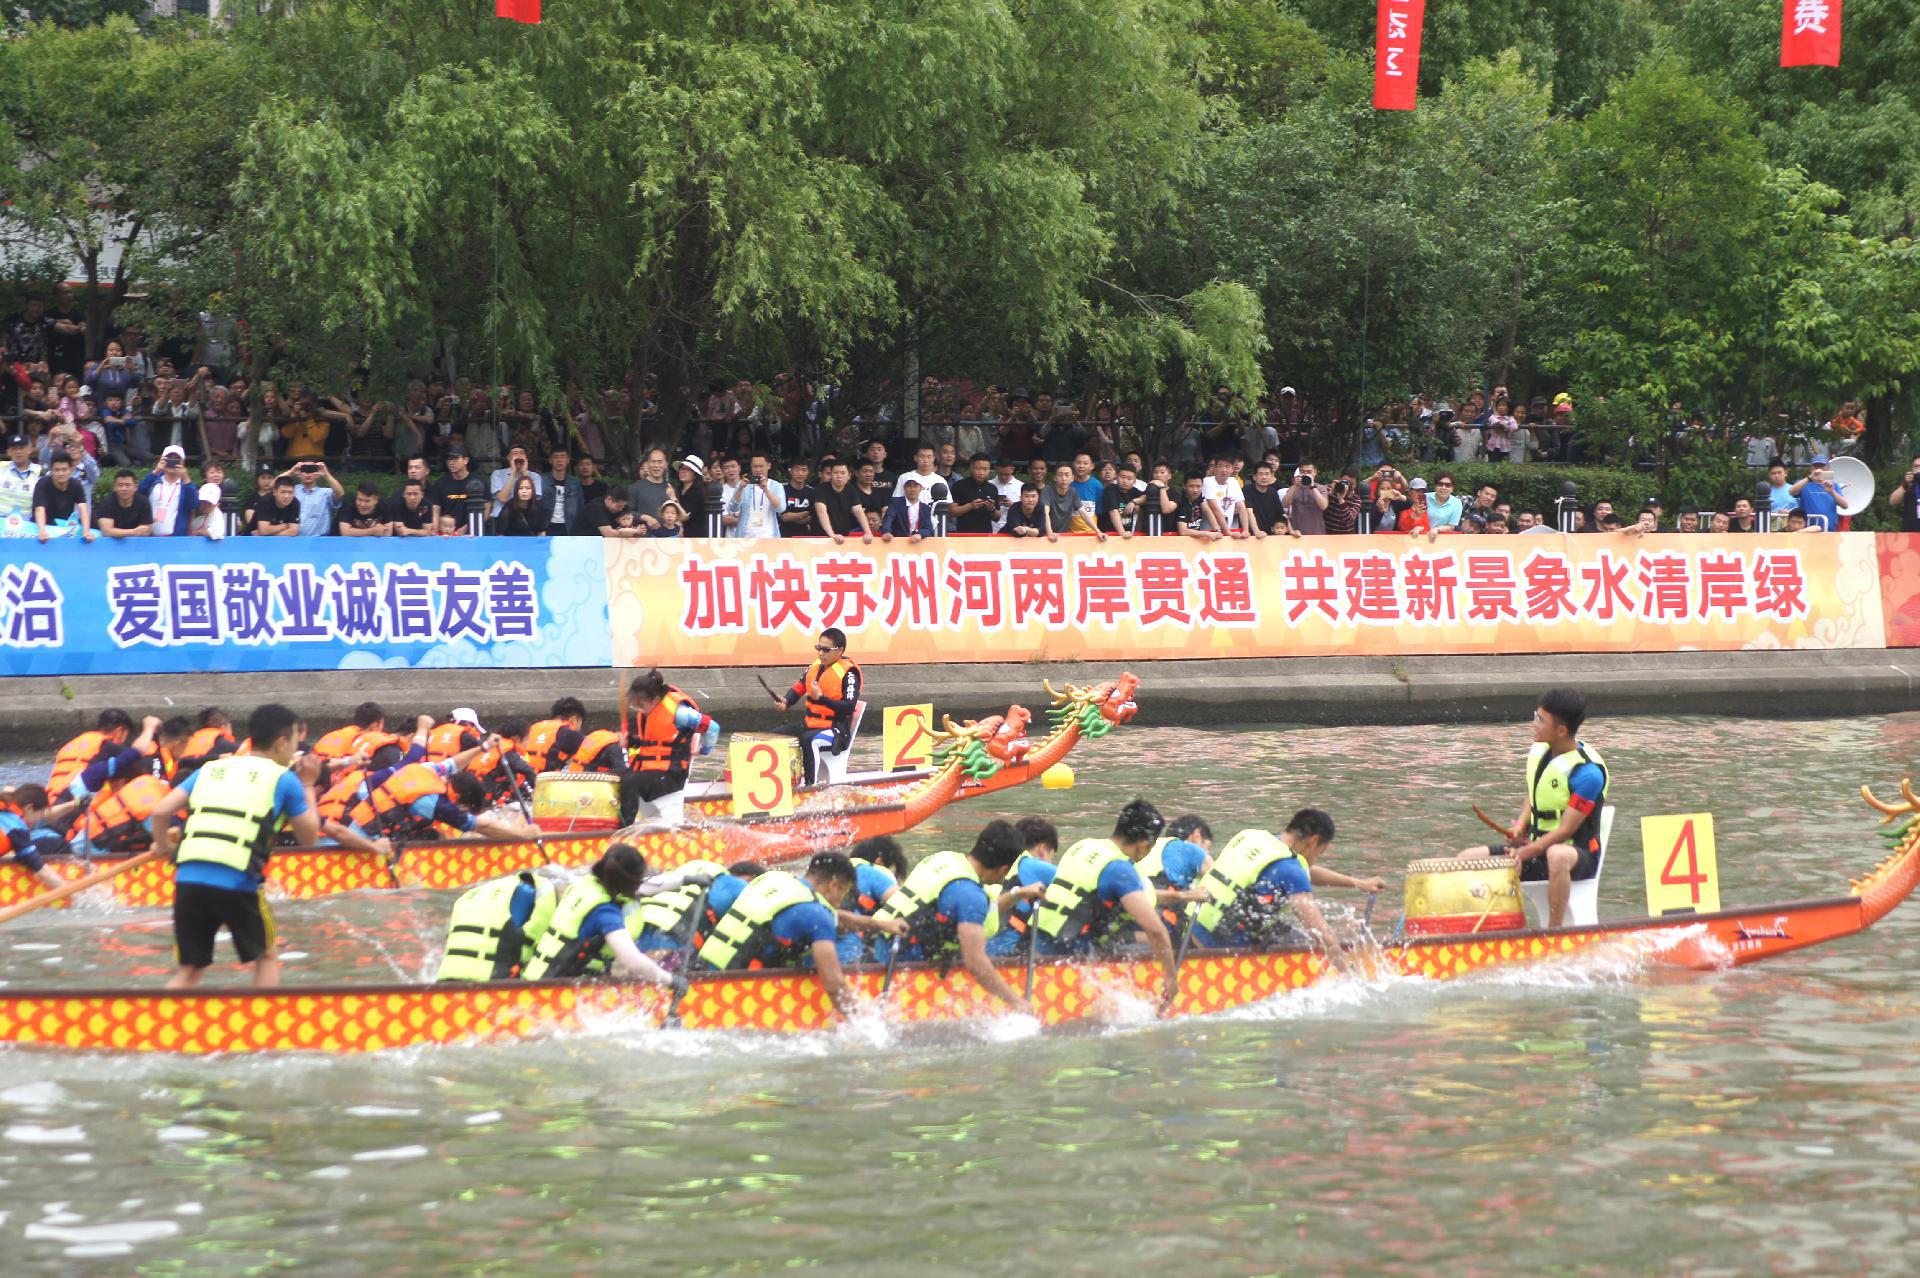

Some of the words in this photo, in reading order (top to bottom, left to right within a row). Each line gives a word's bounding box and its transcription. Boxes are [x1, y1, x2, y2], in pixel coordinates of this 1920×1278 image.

[788, 497, 809, 508] FILA
[0, 567, 58, 642] 治
[112, 566, 535, 642] 爱国敬业诚信友善
[684, 558, 1255, 629] 加快苏州河两岸贯通
[1285, 554, 1806, 621] 共建新景象水清岸绿
[895, 709, 924, 766] 2
[744, 743, 785, 810] 3
[1660, 818, 1708, 904] 4
